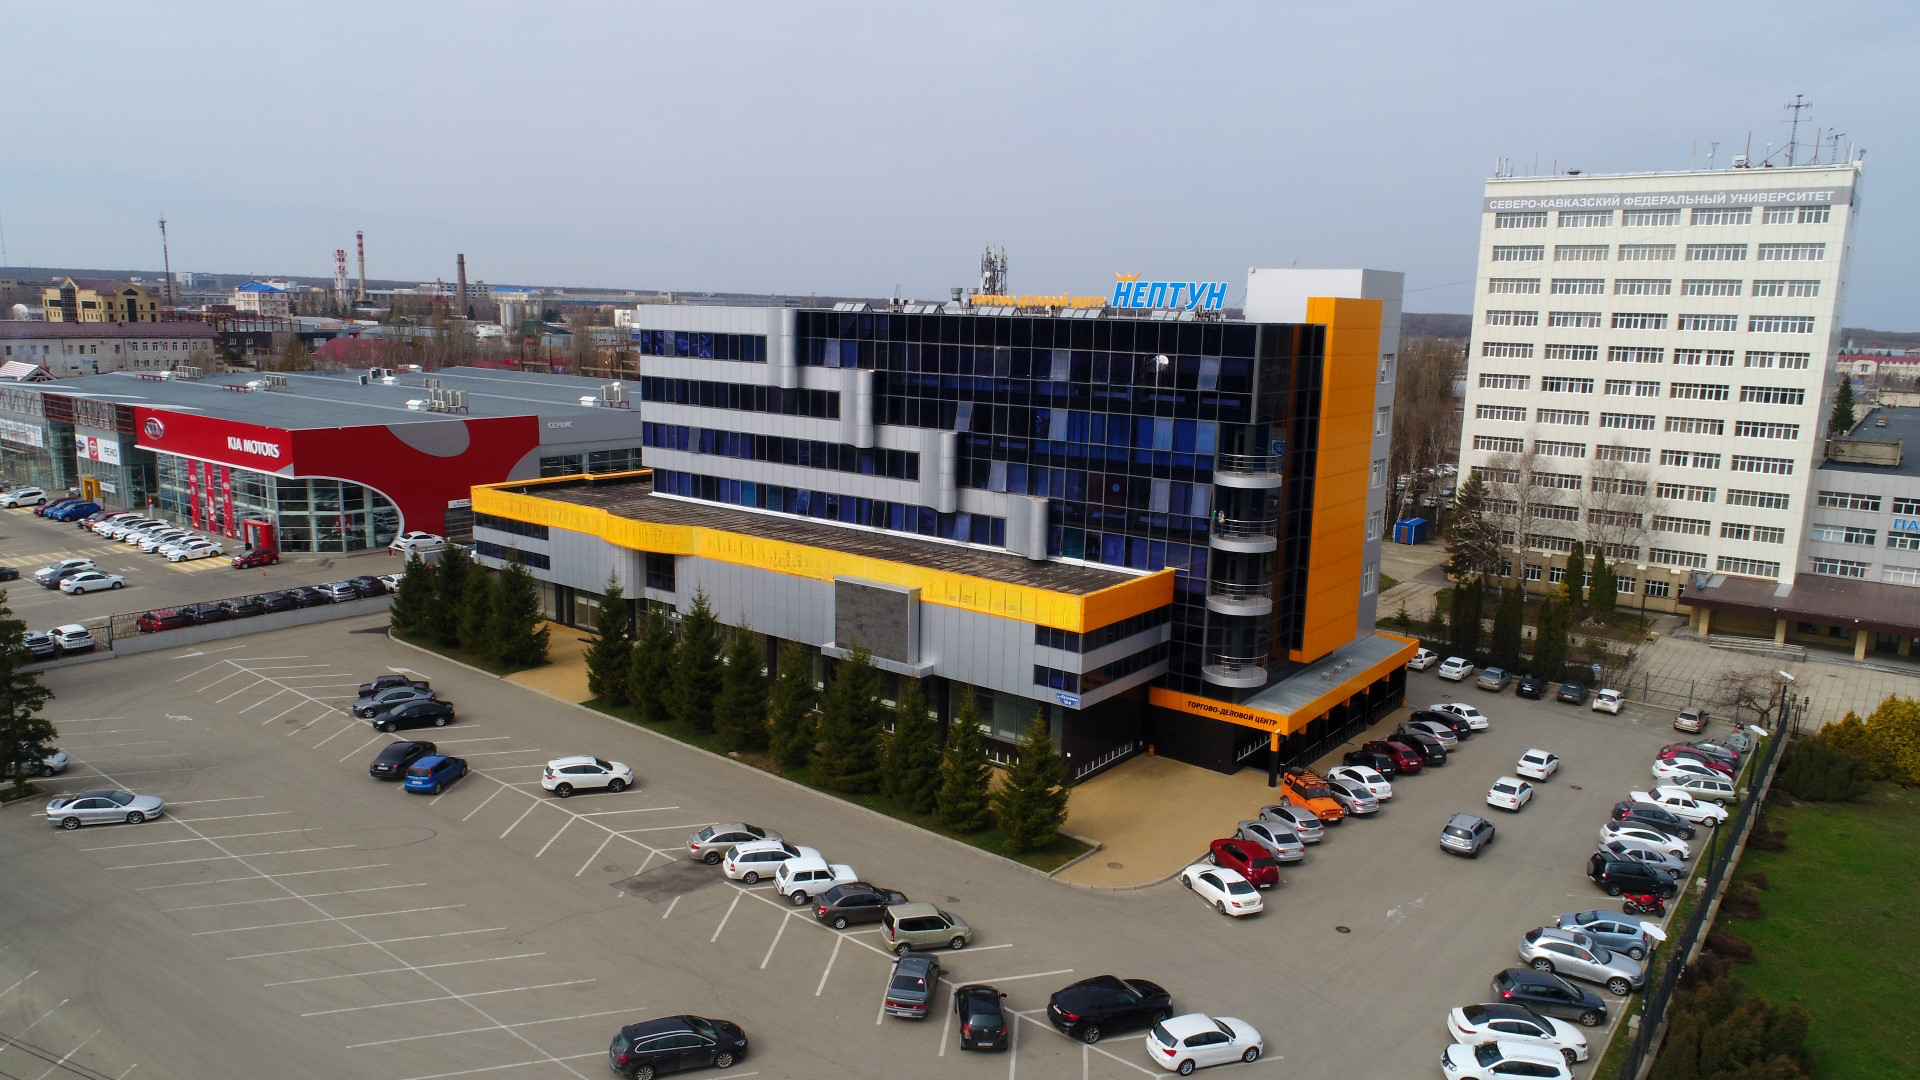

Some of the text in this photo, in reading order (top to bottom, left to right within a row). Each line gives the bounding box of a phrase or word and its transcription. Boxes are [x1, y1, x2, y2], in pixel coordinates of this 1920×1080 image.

[1489, 190, 1835, 210] СЕВЕРО-КАВКАЗСКИЙ ФЕДЕРАЛЬНЫЙ УНИВЕРСИТЕТ
[970, 292, 1107, 309] ТОРГОВО-ДЕЛОВОЙ ЦЕНТР
[1111, 281, 1229, 312] НЕПТУН
[227, 436, 280, 459] KIA MOTORS
[1893, 518, 1920, 531] ПА
[1187, 700, 1278, 726] ТОРГОВО-ДЕЛОВОЙ ЦЕНТР
